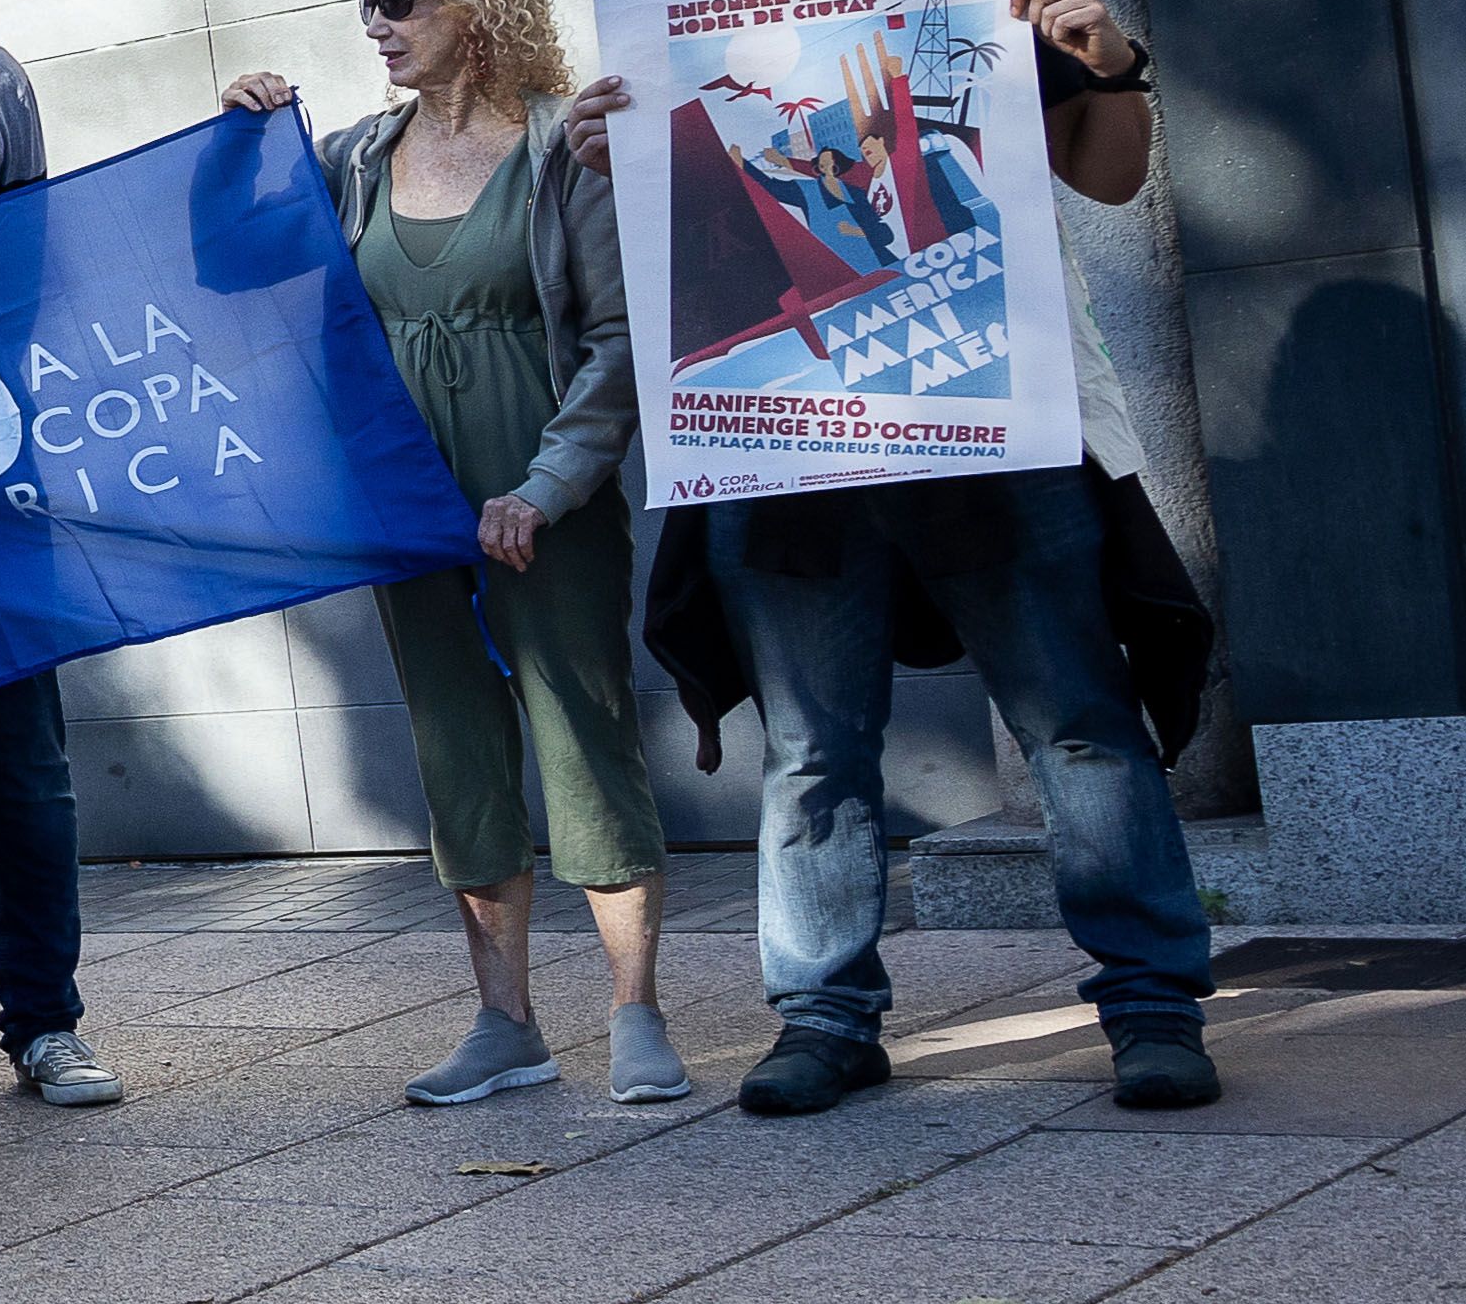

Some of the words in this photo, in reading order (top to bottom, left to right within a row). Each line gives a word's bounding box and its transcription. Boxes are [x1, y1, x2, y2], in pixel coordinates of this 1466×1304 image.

[668, 14, 745, 37] MODEL
[753, 8, 784, 25] DE
[904, 225, 1000, 278] COPA
[30, 343, 73, 391] A
[91, 303, 193, 368] LA
[844, 302, 965, 387] MAI
[31, 363, 239, 456] COPA
[671, 392, 866, 417] MANIFESTACIÓ
[670, 413, 809, 437] DIUMENGE
[816, 420, 846, 438] 13
[853, 421, 1006, 444] D'OCTUBRE
[669, 434, 706, 446] 12H.
[710, 436, 765, 452] PLAÇA
[769, 439, 792, 451] DE
[797, 440, 880, 454] CORREUS
[884, 443, 1005, 459] (BARCELONA)
[719, 473, 758, 486] COPA
